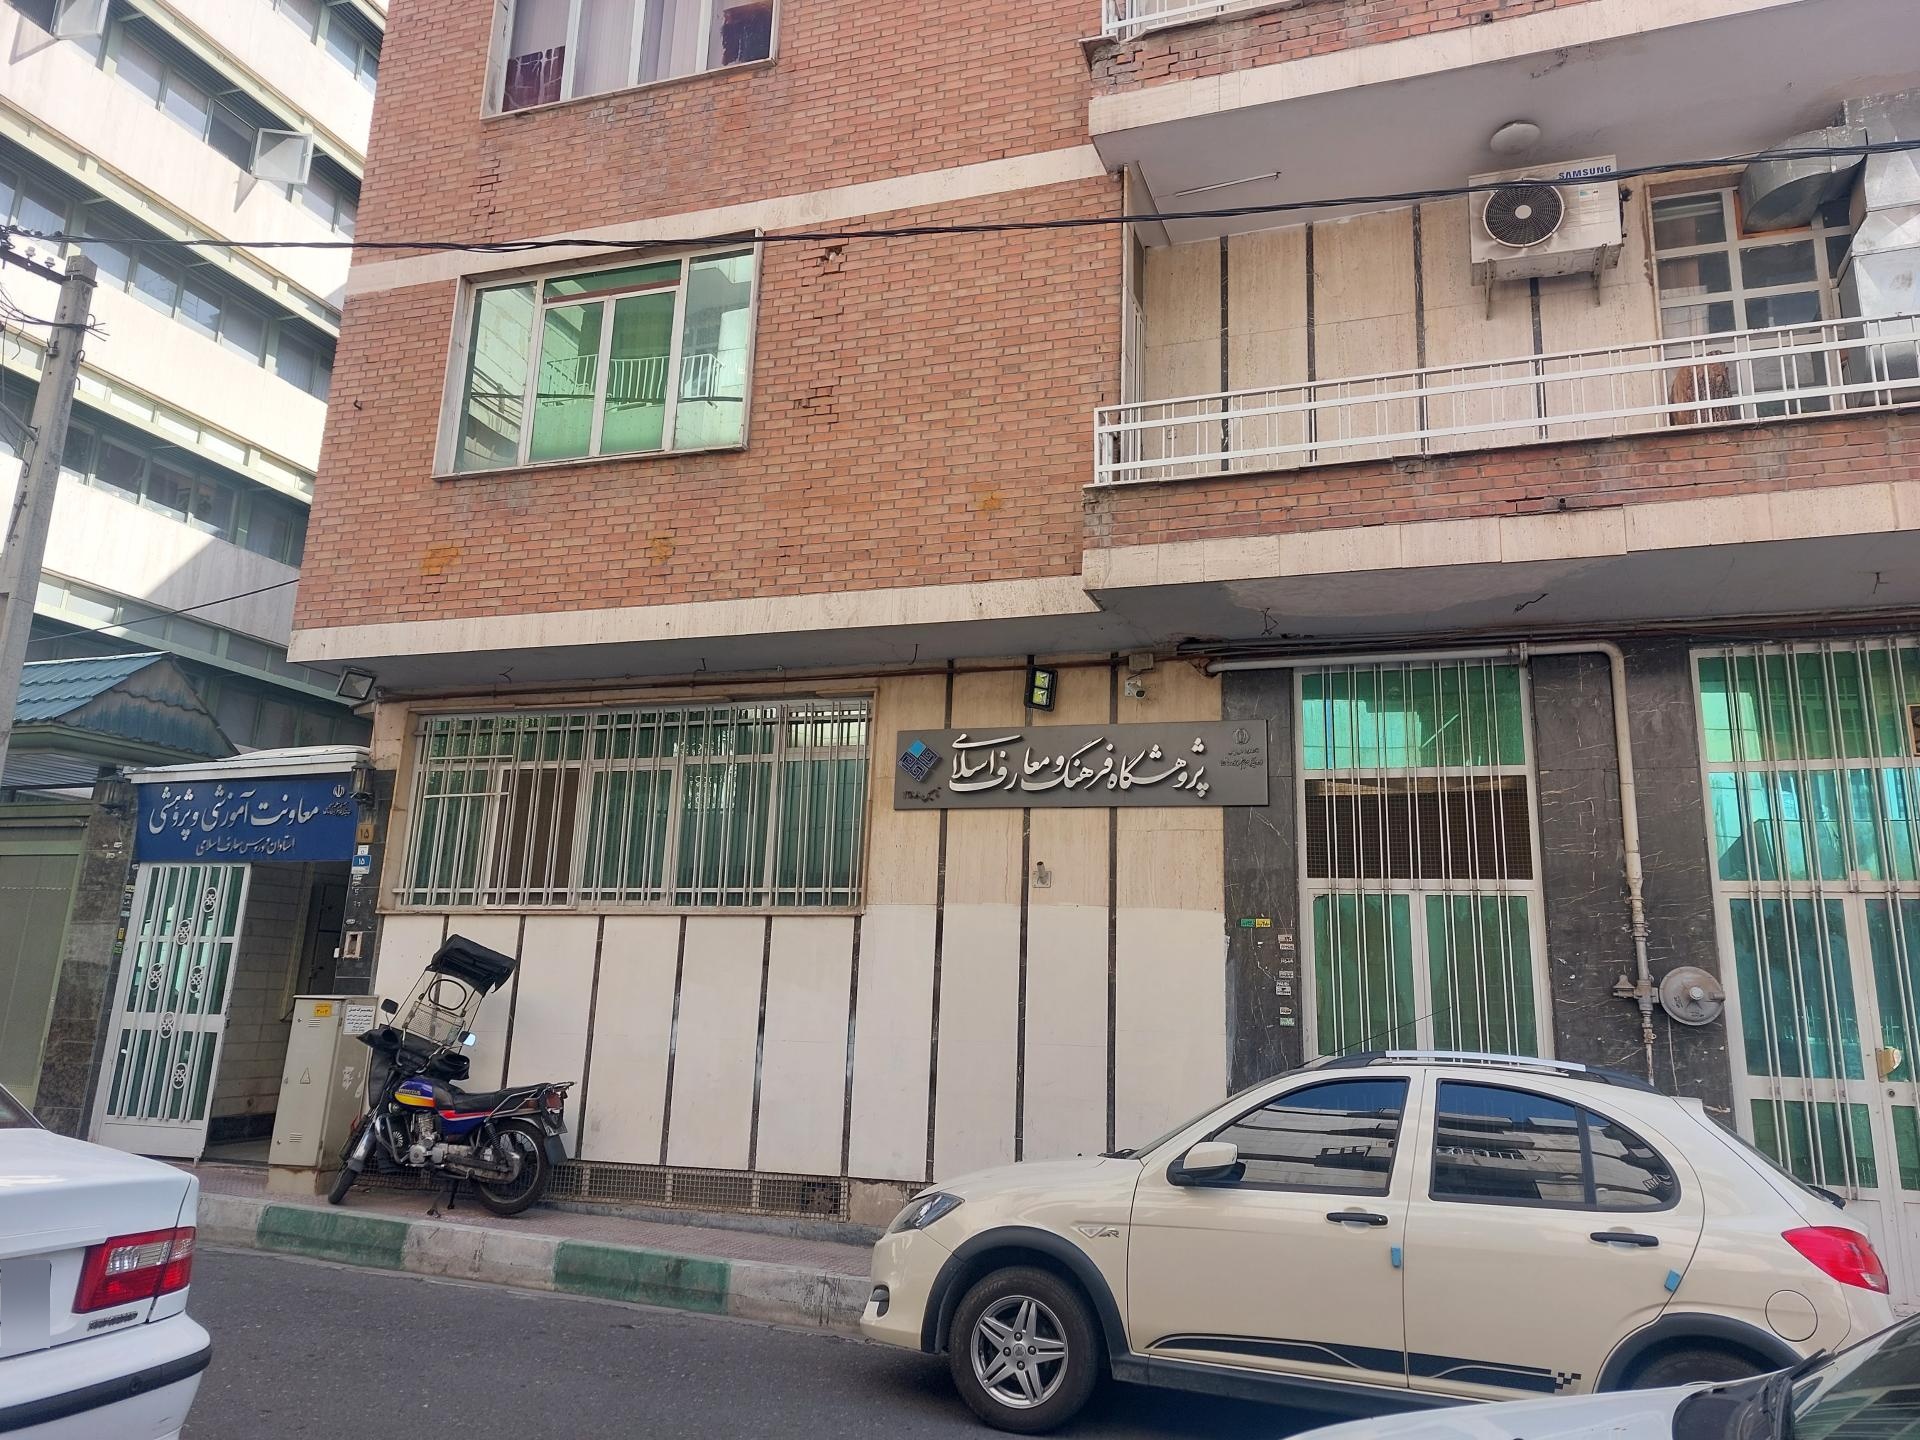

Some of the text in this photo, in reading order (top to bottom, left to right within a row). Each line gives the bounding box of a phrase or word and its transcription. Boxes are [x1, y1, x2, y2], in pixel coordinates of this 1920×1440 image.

[1558, 165, 1612, 180] SAMSUNG
[948, 732, 1210, 798] پژوهشگاه فرهنگ و معارف اسلامی
[148, 783, 320, 841] معاونت آموزشی و پژوهشی
[359, 827, 370, 840] ۱۵
